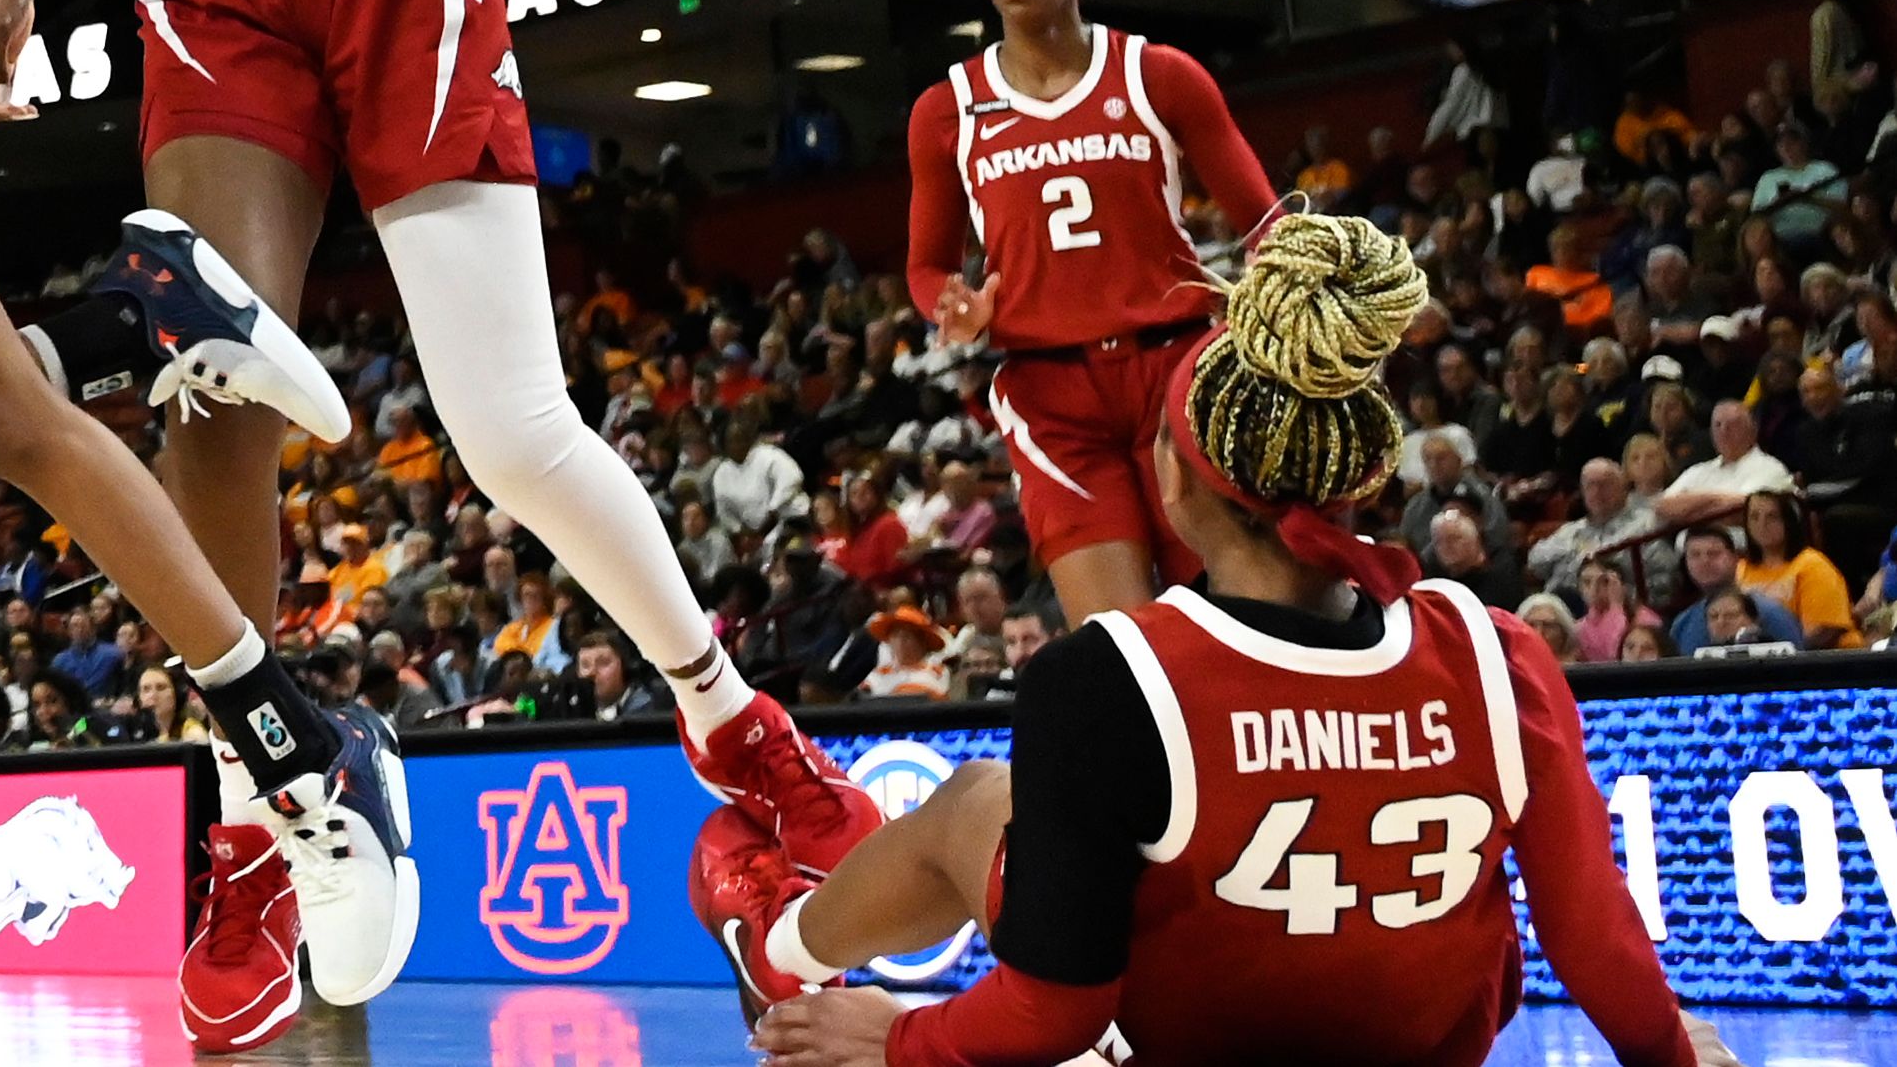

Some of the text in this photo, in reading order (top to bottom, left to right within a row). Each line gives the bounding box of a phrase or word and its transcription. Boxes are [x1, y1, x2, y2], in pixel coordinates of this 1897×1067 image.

[975, 133, 1151, 187] ARKANSAS
[1042, 175, 1101, 251] 2
[1231, 700, 1456, 773] DANIELS
[1216, 794, 1494, 934] 43
